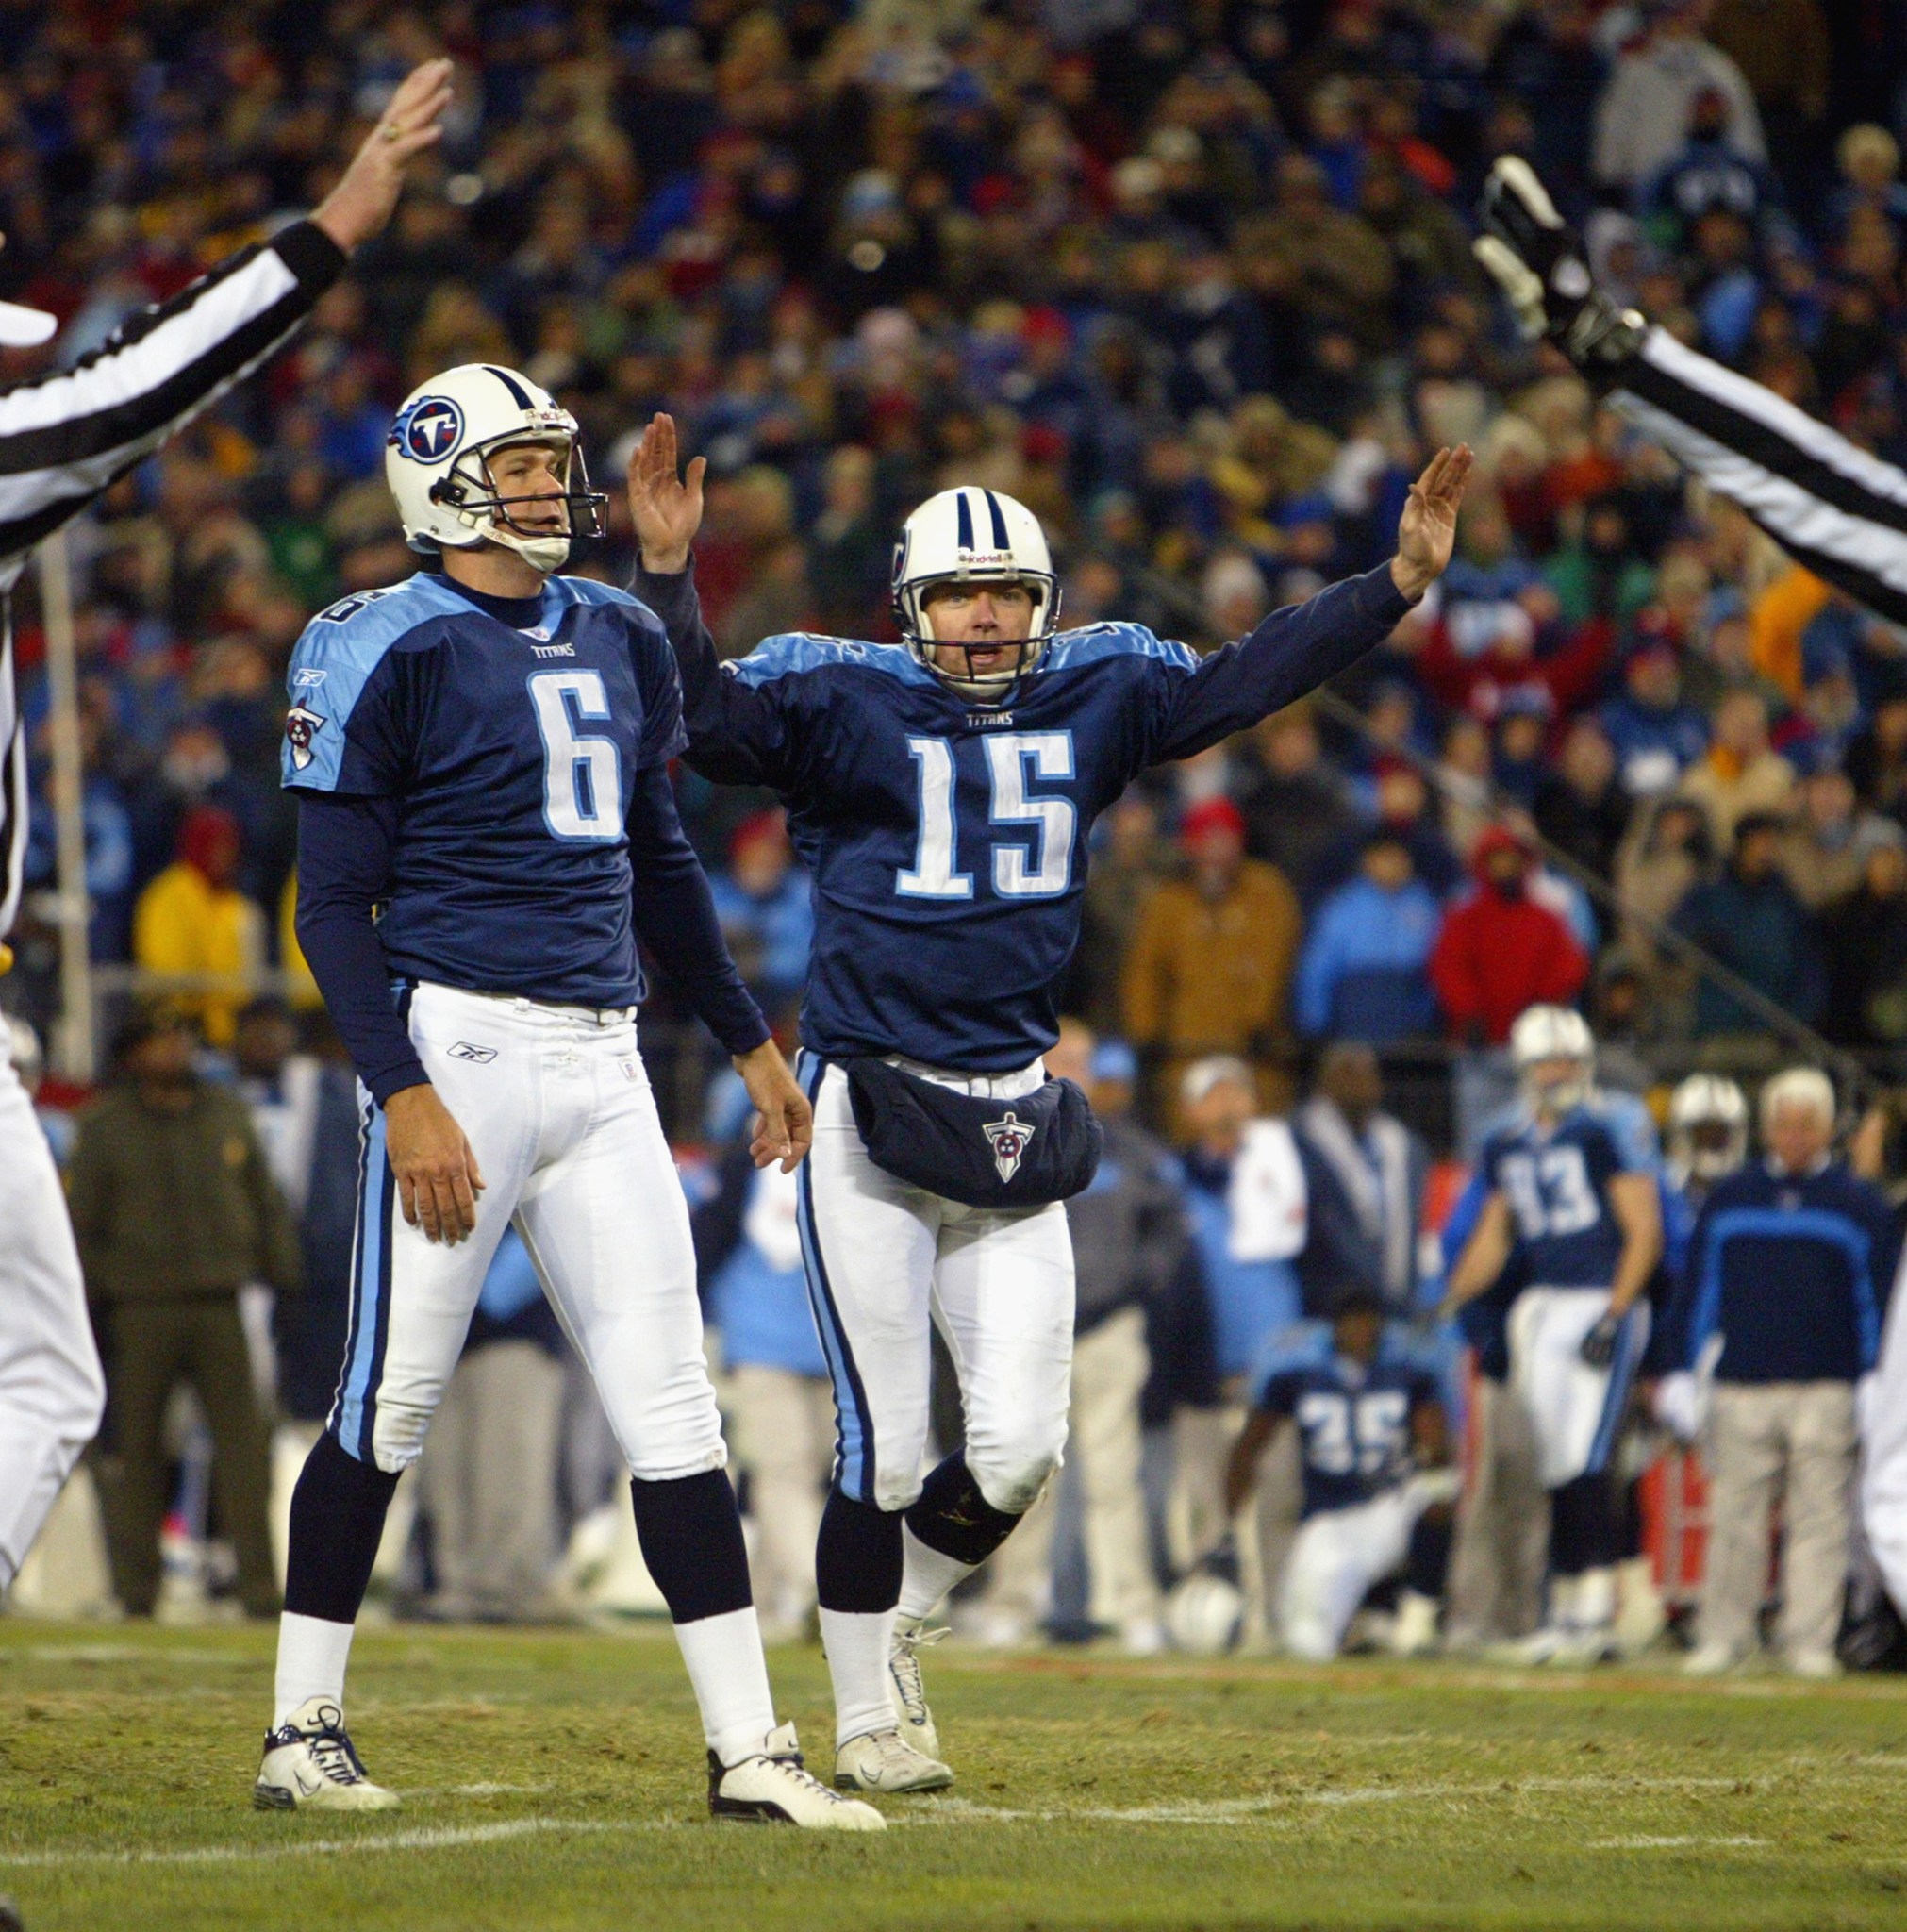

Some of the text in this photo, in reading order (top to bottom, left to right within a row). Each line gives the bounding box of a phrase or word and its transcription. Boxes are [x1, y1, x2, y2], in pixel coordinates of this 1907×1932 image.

[530, 642, 576, 658] TITANS
[525, 668, 624, 844] 6
[966, 711, 1014, 727] TITANS
[895, 729, 1078, 900] 15
